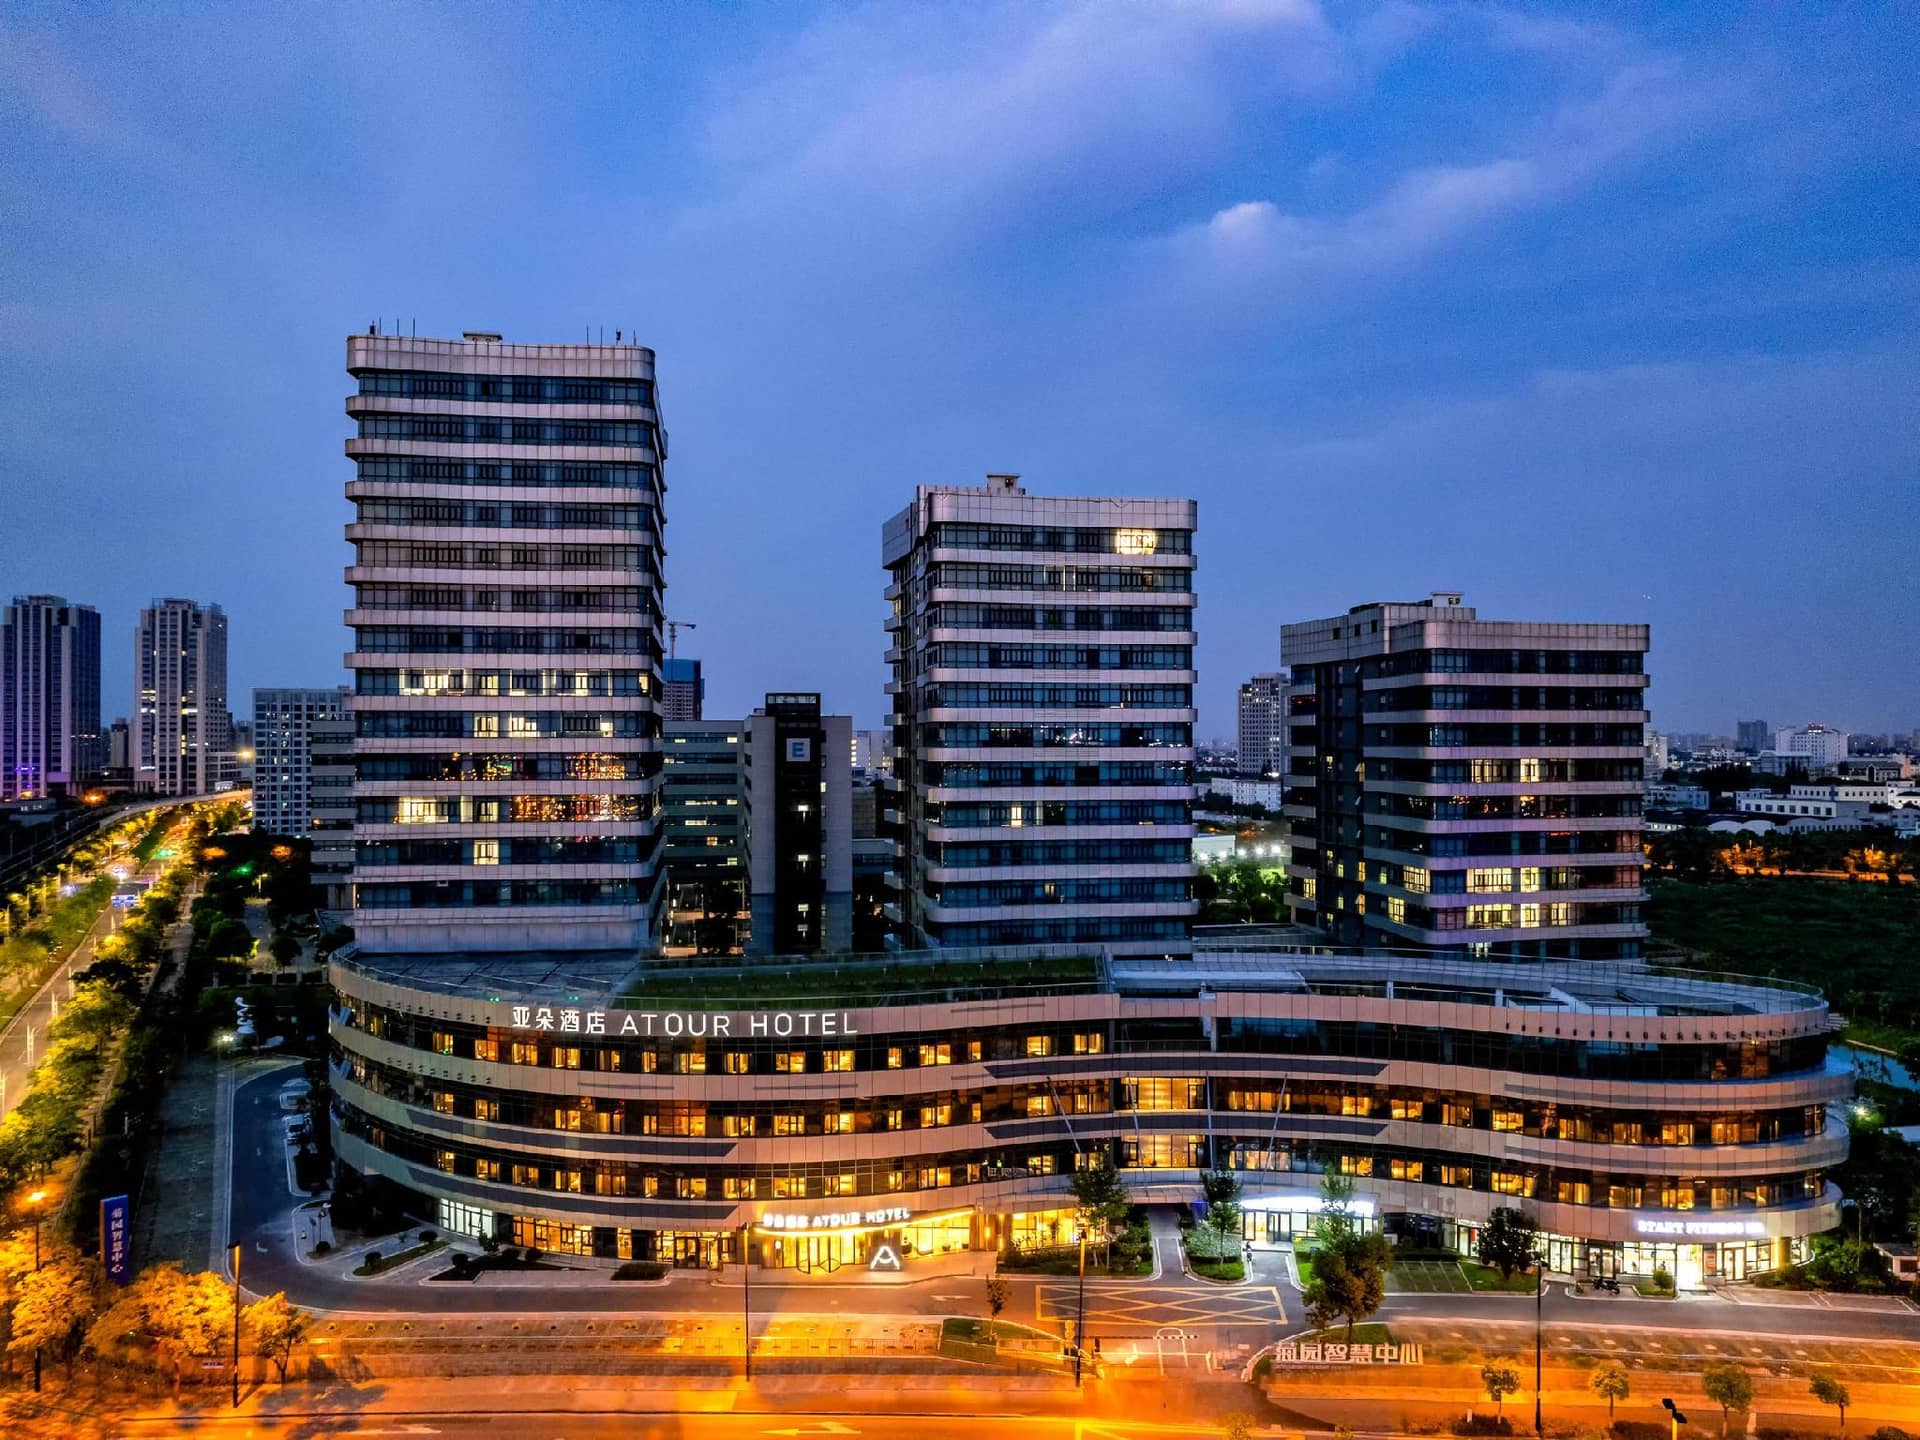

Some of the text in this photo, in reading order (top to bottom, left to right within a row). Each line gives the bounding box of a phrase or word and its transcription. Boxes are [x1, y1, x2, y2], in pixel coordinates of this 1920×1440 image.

[512, 1006, 858, 1037] 亚朵酒店 ATOUR HOTEL
